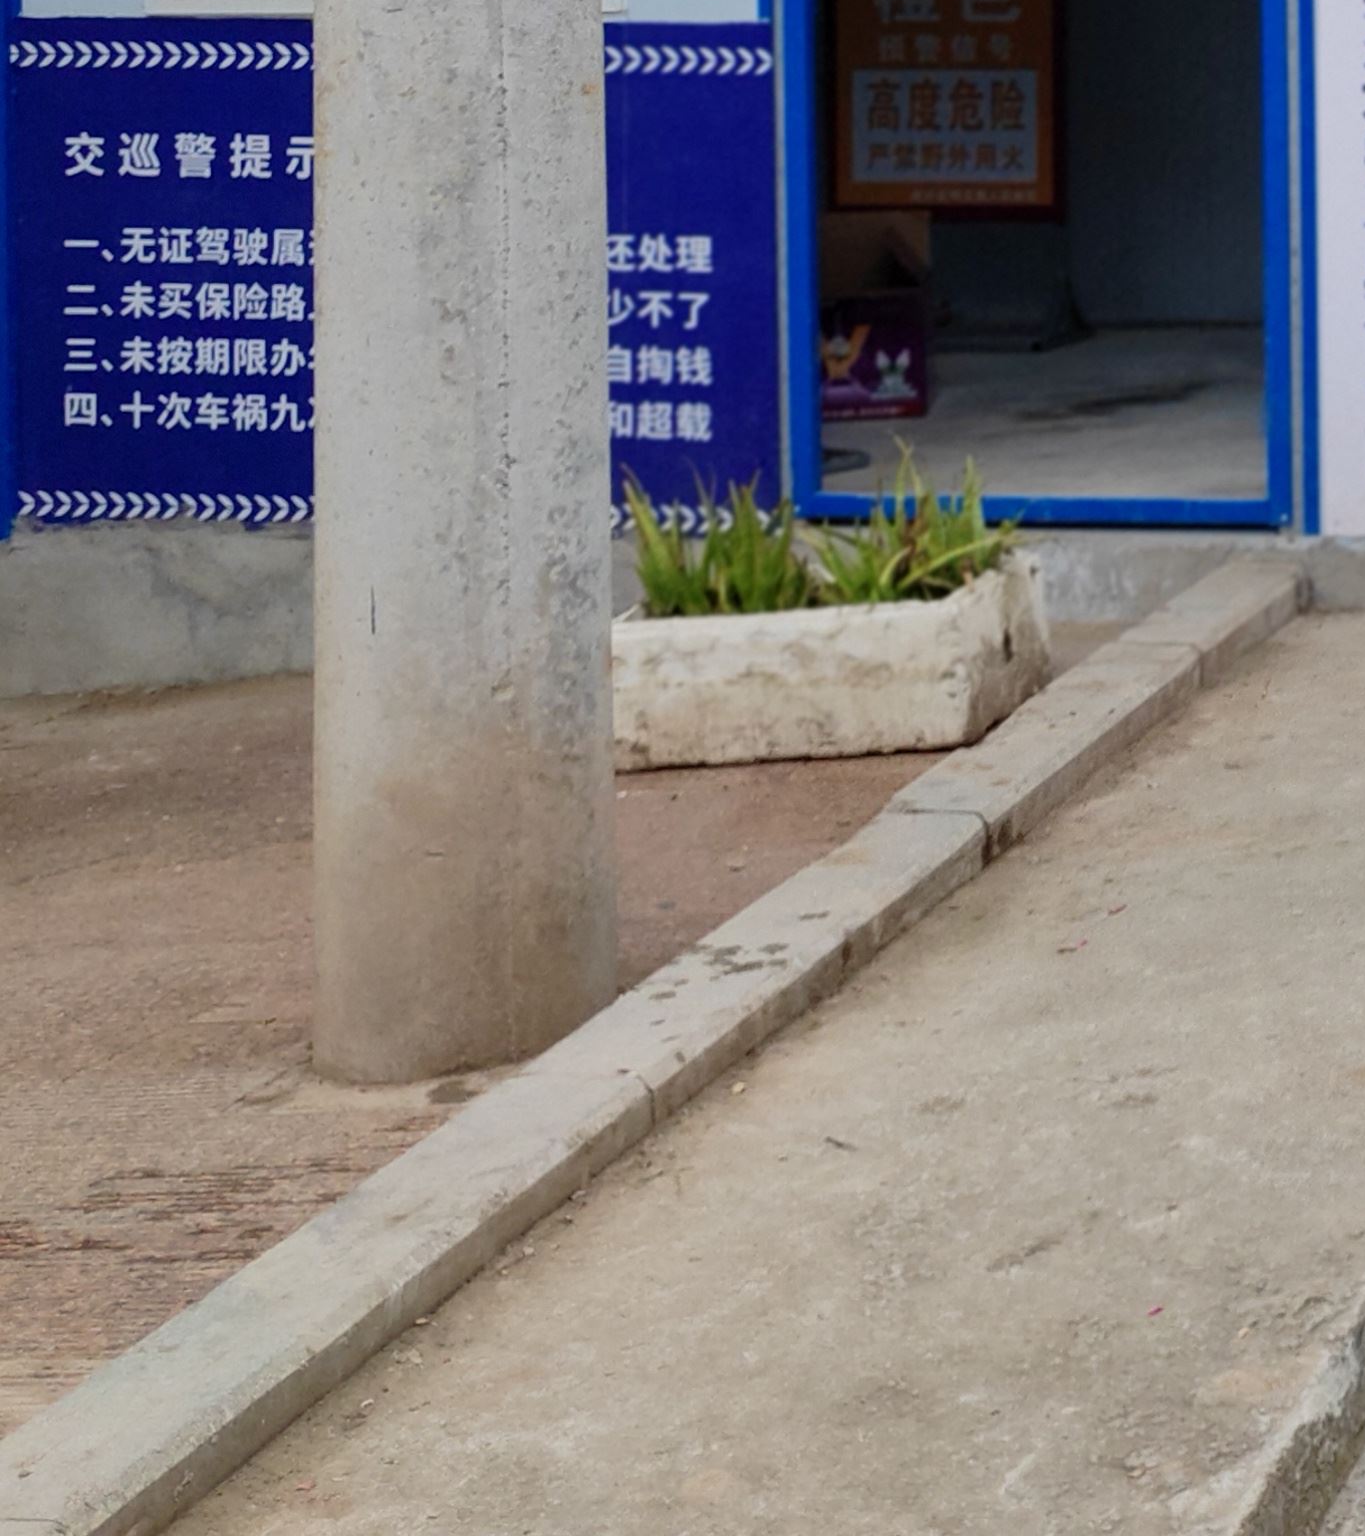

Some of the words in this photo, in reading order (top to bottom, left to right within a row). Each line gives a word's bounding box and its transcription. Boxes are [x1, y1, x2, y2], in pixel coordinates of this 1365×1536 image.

[867, 77, 1026, 132] 高度危险
[63, 226, 314, 267] 一、无证驾驶属
[63, 280, 314, 322] 二、未买保险路
[63, 335, 314, 377] 三、未按期限办
[63, 390, 314, 432] 四、十次车祸九
